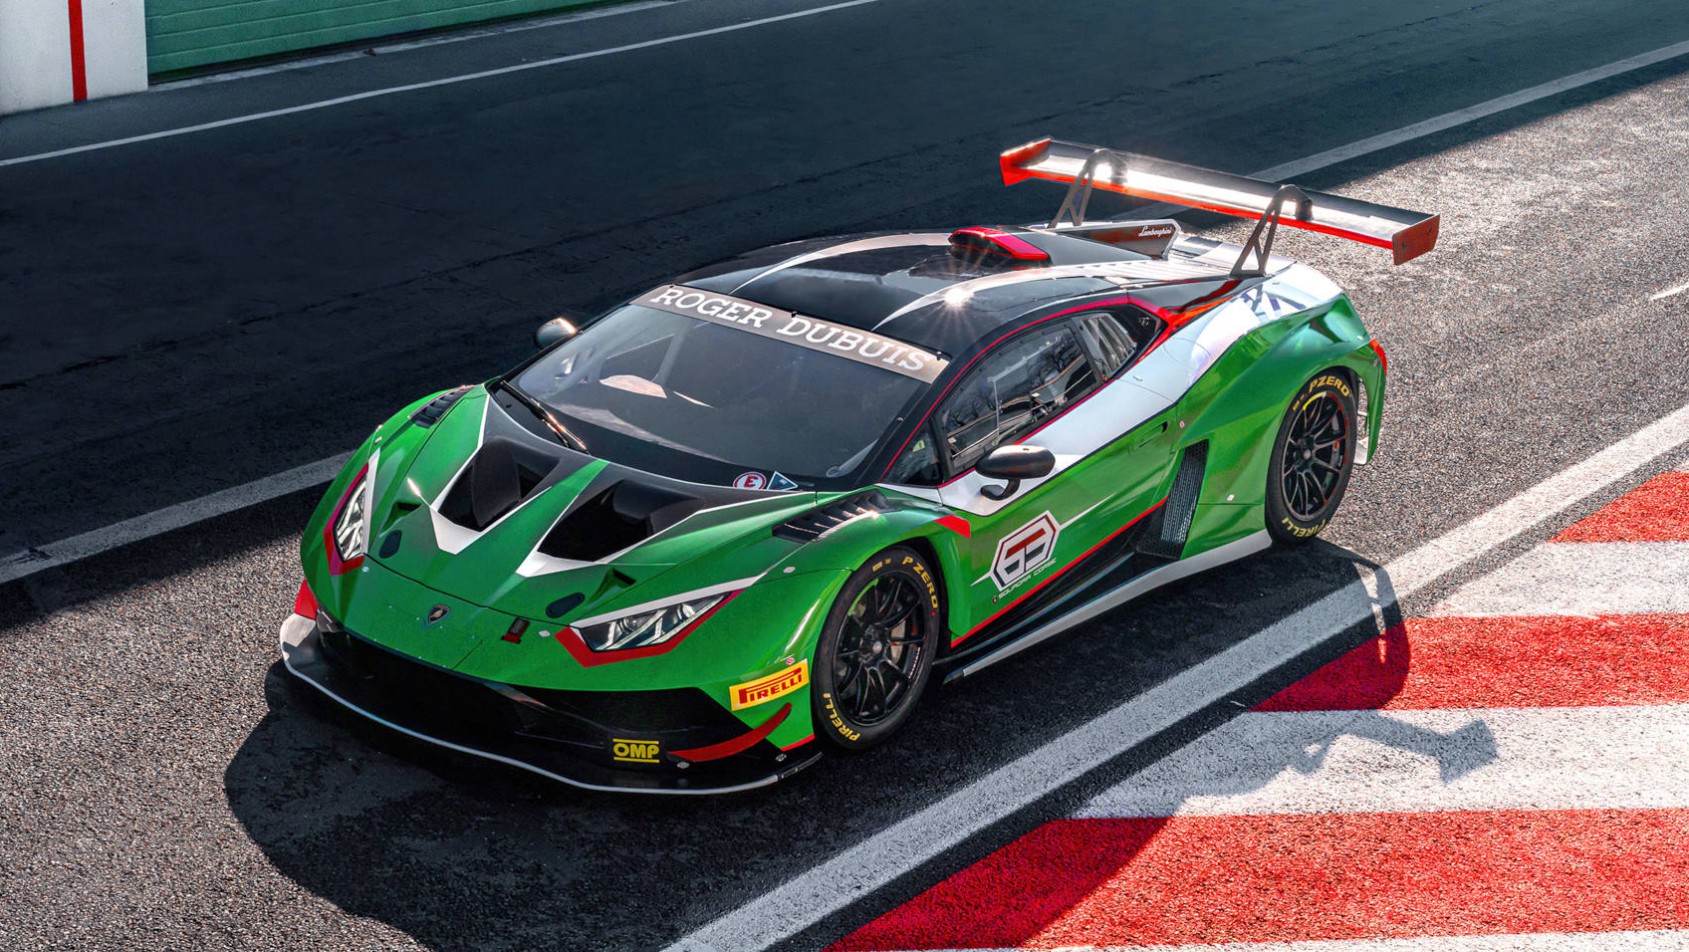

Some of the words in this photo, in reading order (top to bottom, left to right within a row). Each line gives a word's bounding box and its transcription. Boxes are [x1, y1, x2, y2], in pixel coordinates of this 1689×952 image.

[651, 288, 773, 328] ROGER
[776, 317, 933, 372] DUBUIS
[738, 667, 802, 704] PIRELLI
[823, 693, 860, 741] PIRELLI
[613, 742, 660, 759] OMP
